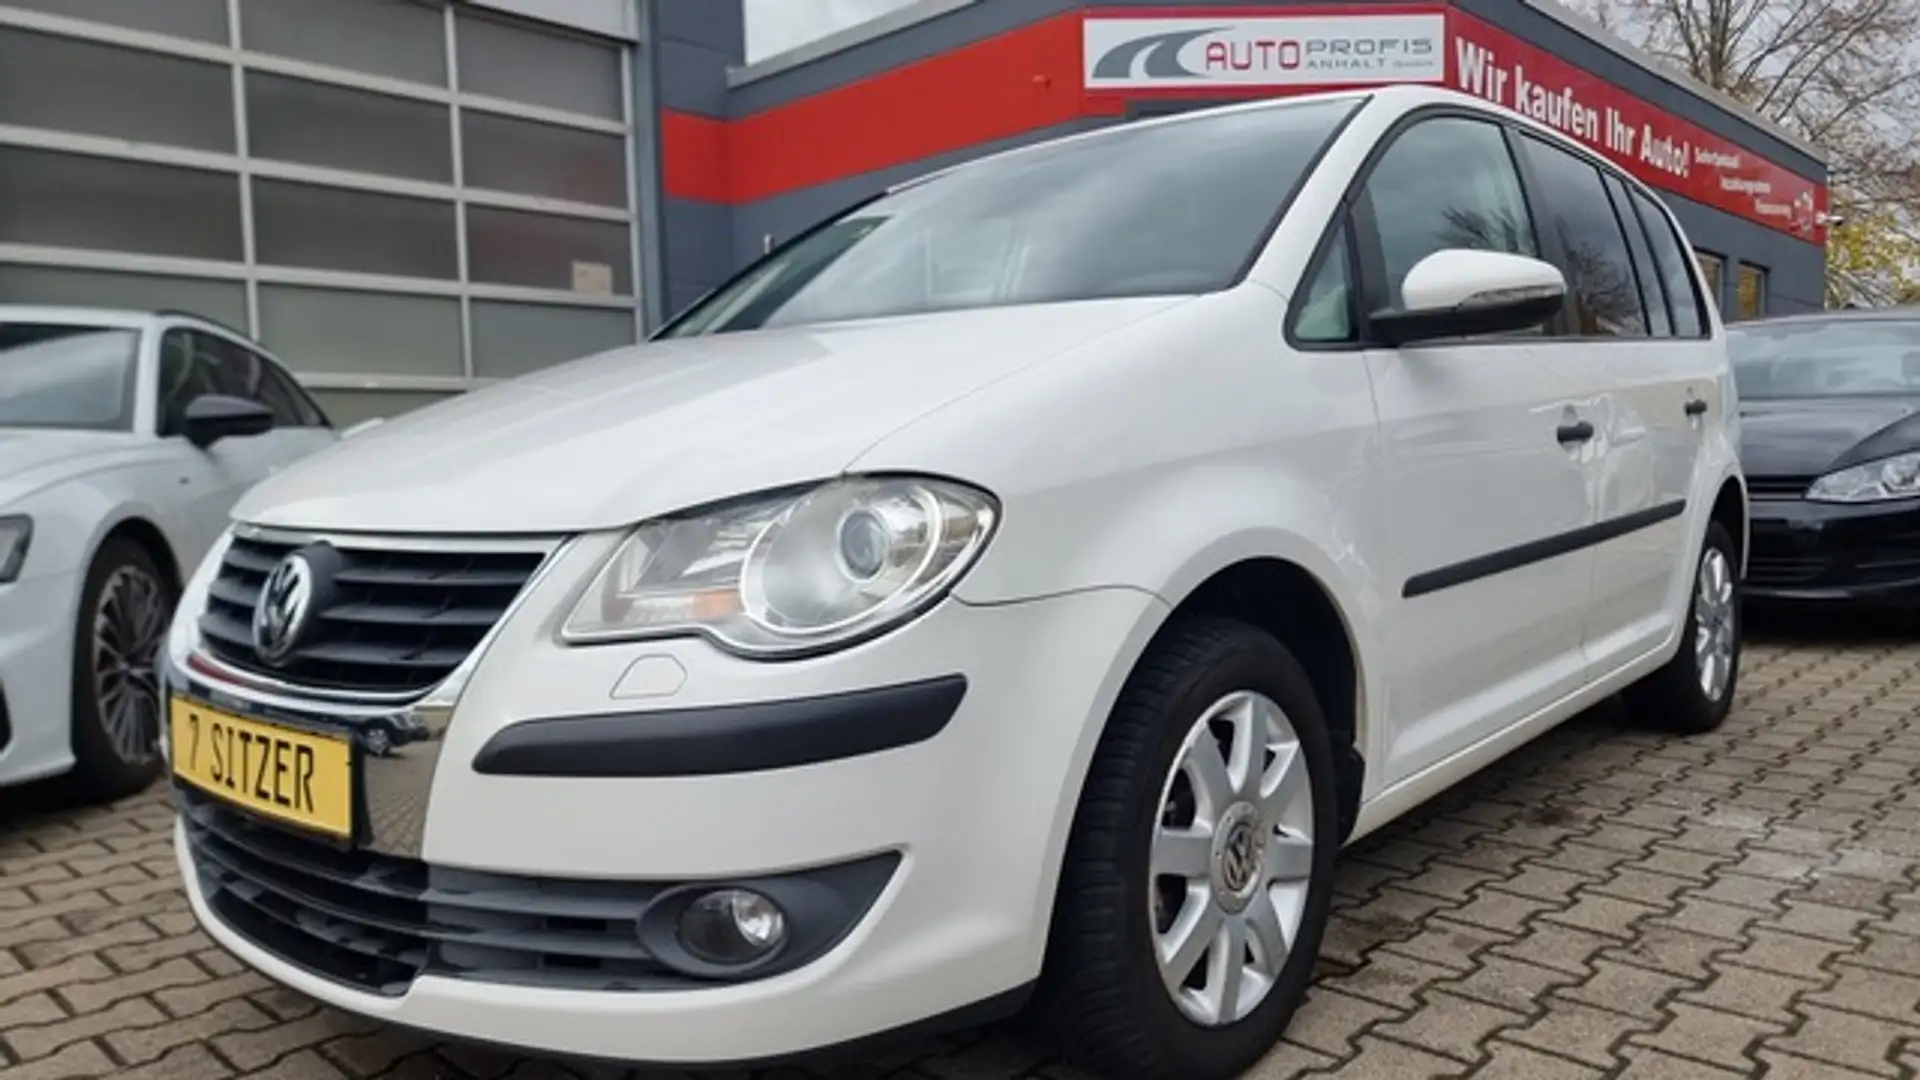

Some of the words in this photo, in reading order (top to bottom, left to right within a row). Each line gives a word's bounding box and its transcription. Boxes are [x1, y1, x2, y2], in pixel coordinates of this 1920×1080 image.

[1205, 40, 1301, 70] AUTO
[1304, 37, 1434, 57] PROFIS
[1305, 57, 1387, 70] ANHALT
[1455, 36, 1508, 104] Wir
[1514, 64, 1599, 143] kaufen
[1604, 106, 1637, 156] Ihr
[1639, 124, 1691, 179] Auto!
[210, 722, 315, 814] SITZER
